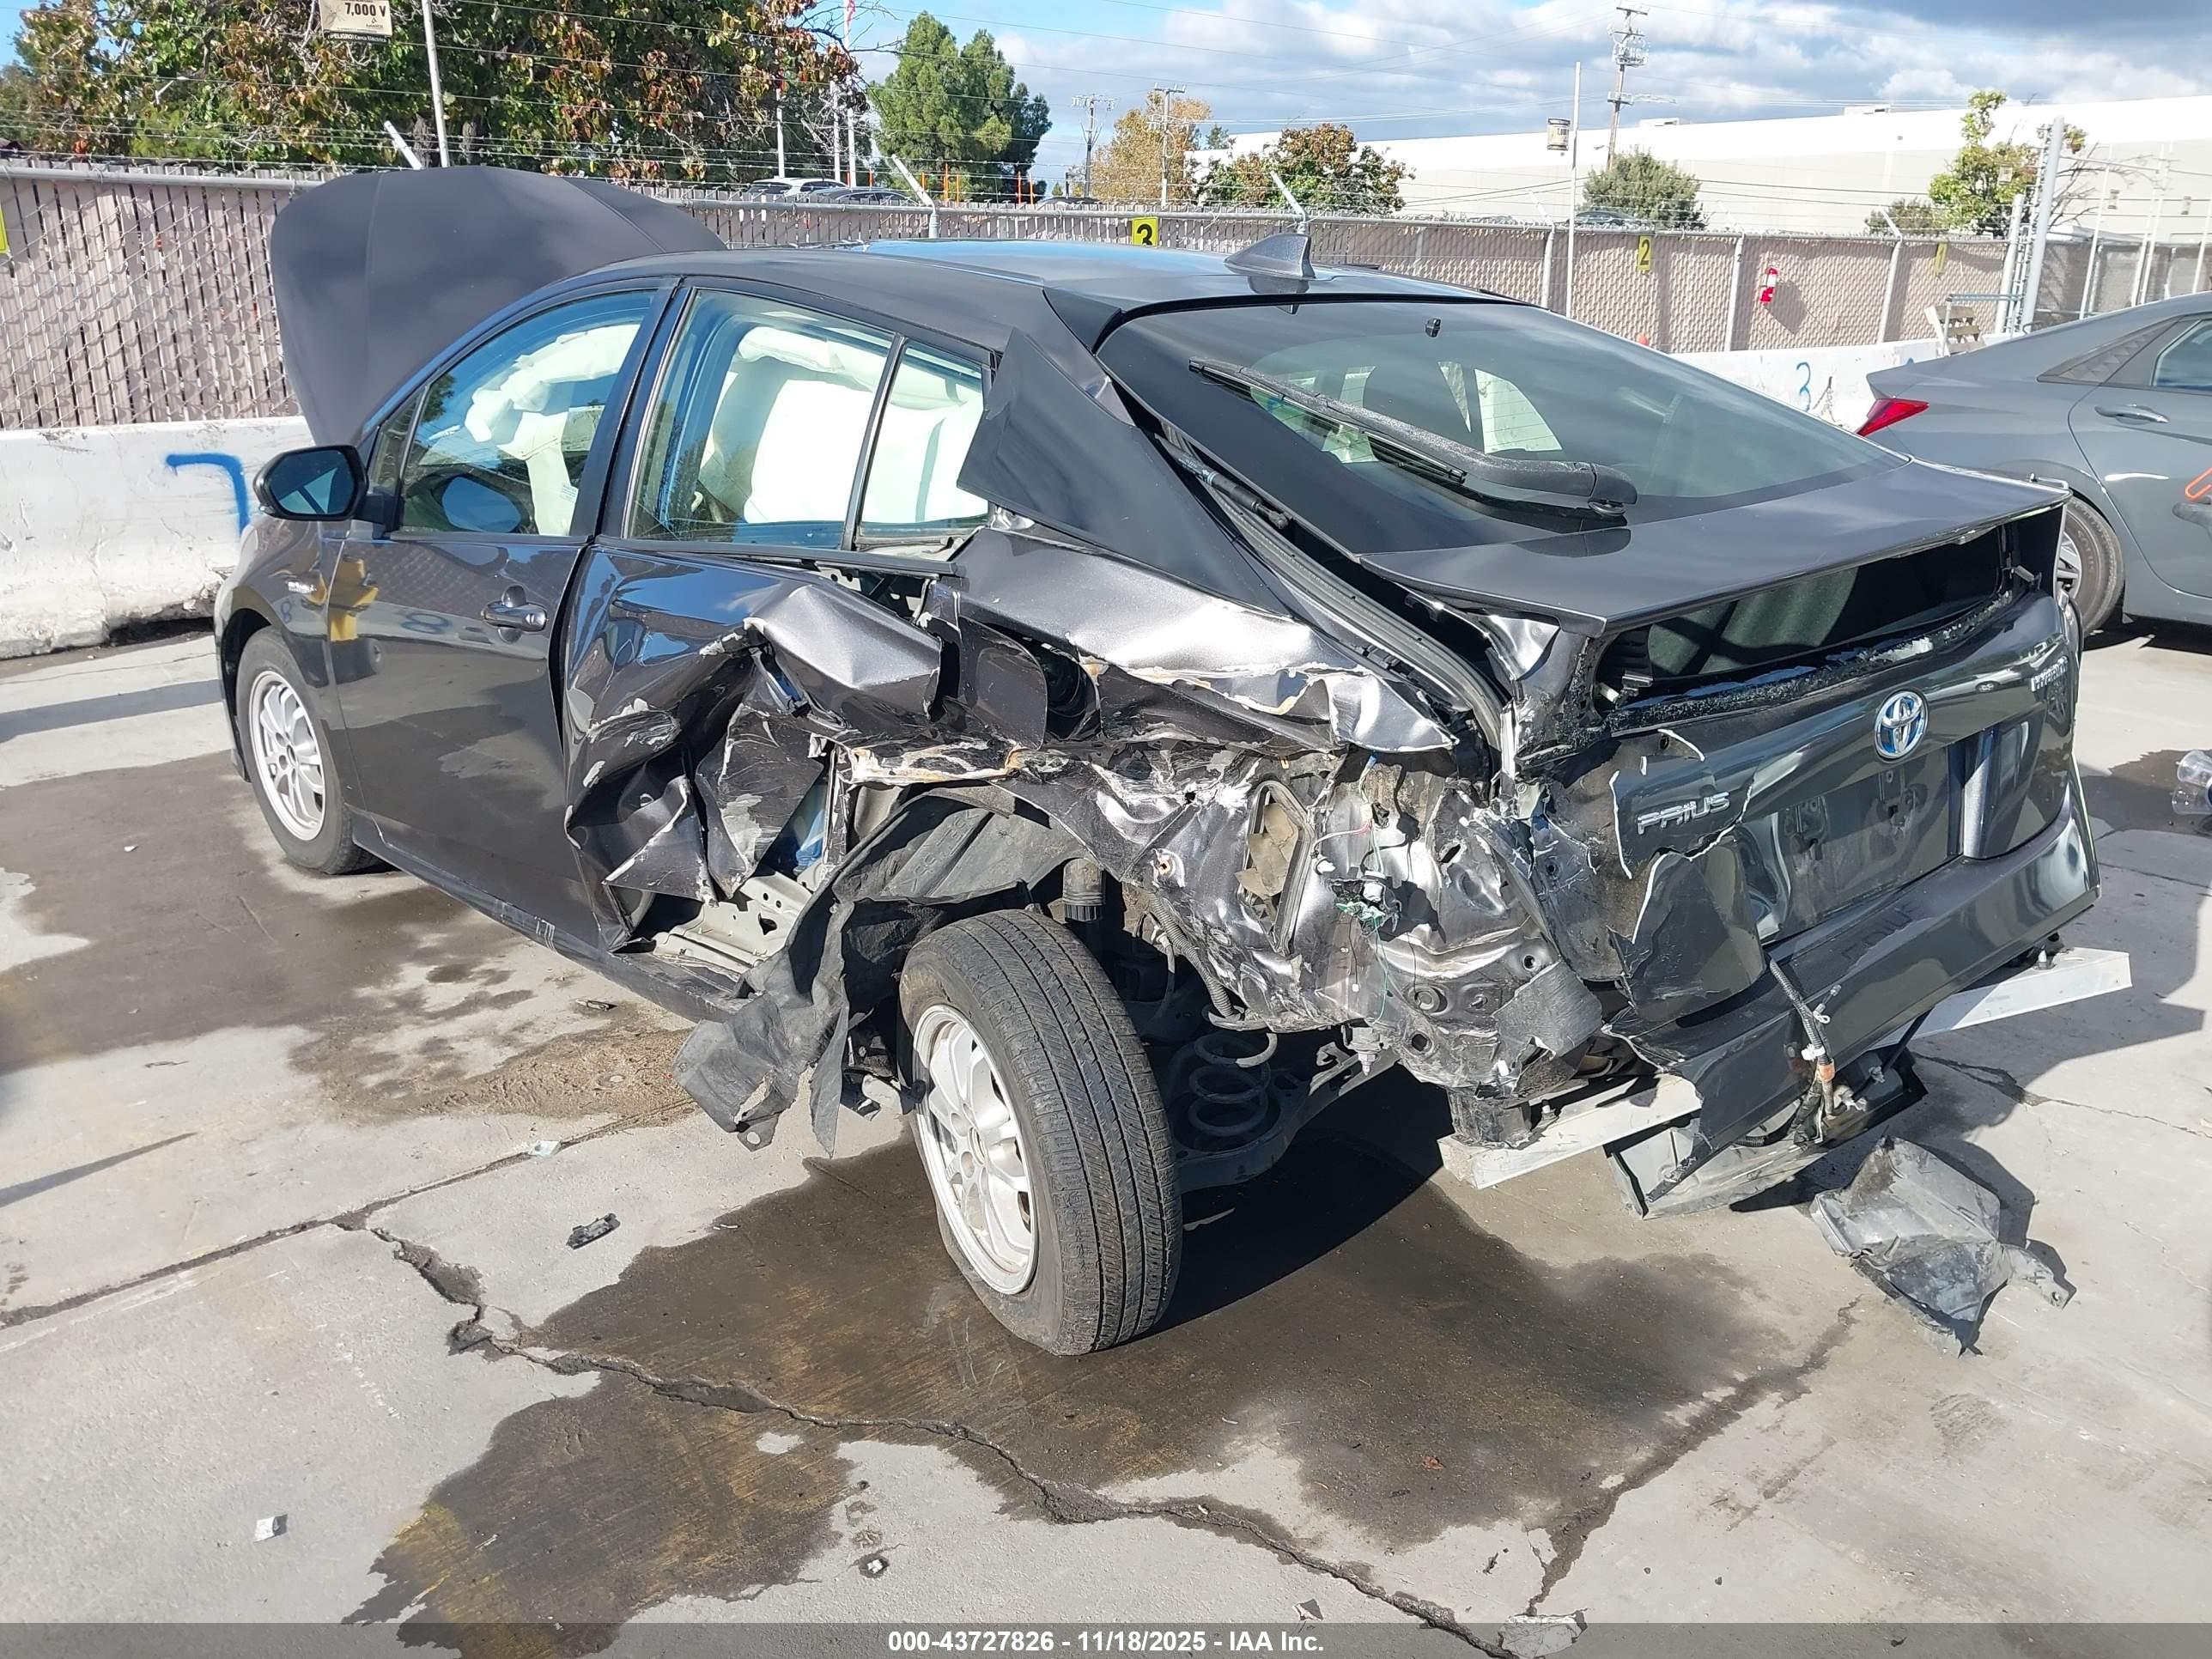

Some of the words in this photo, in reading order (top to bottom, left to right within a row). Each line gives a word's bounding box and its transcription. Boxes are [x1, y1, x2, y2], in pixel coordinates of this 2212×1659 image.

[344, 3, 376, 16] 7,000
[379, 5, 386, 17] V
[1639, 239, 1650, 265] 2
[1796, 362, 1811, 412] 3
[166, 453, 251, 537] 7
[1637, 791, 1730, 836] PRIUS
